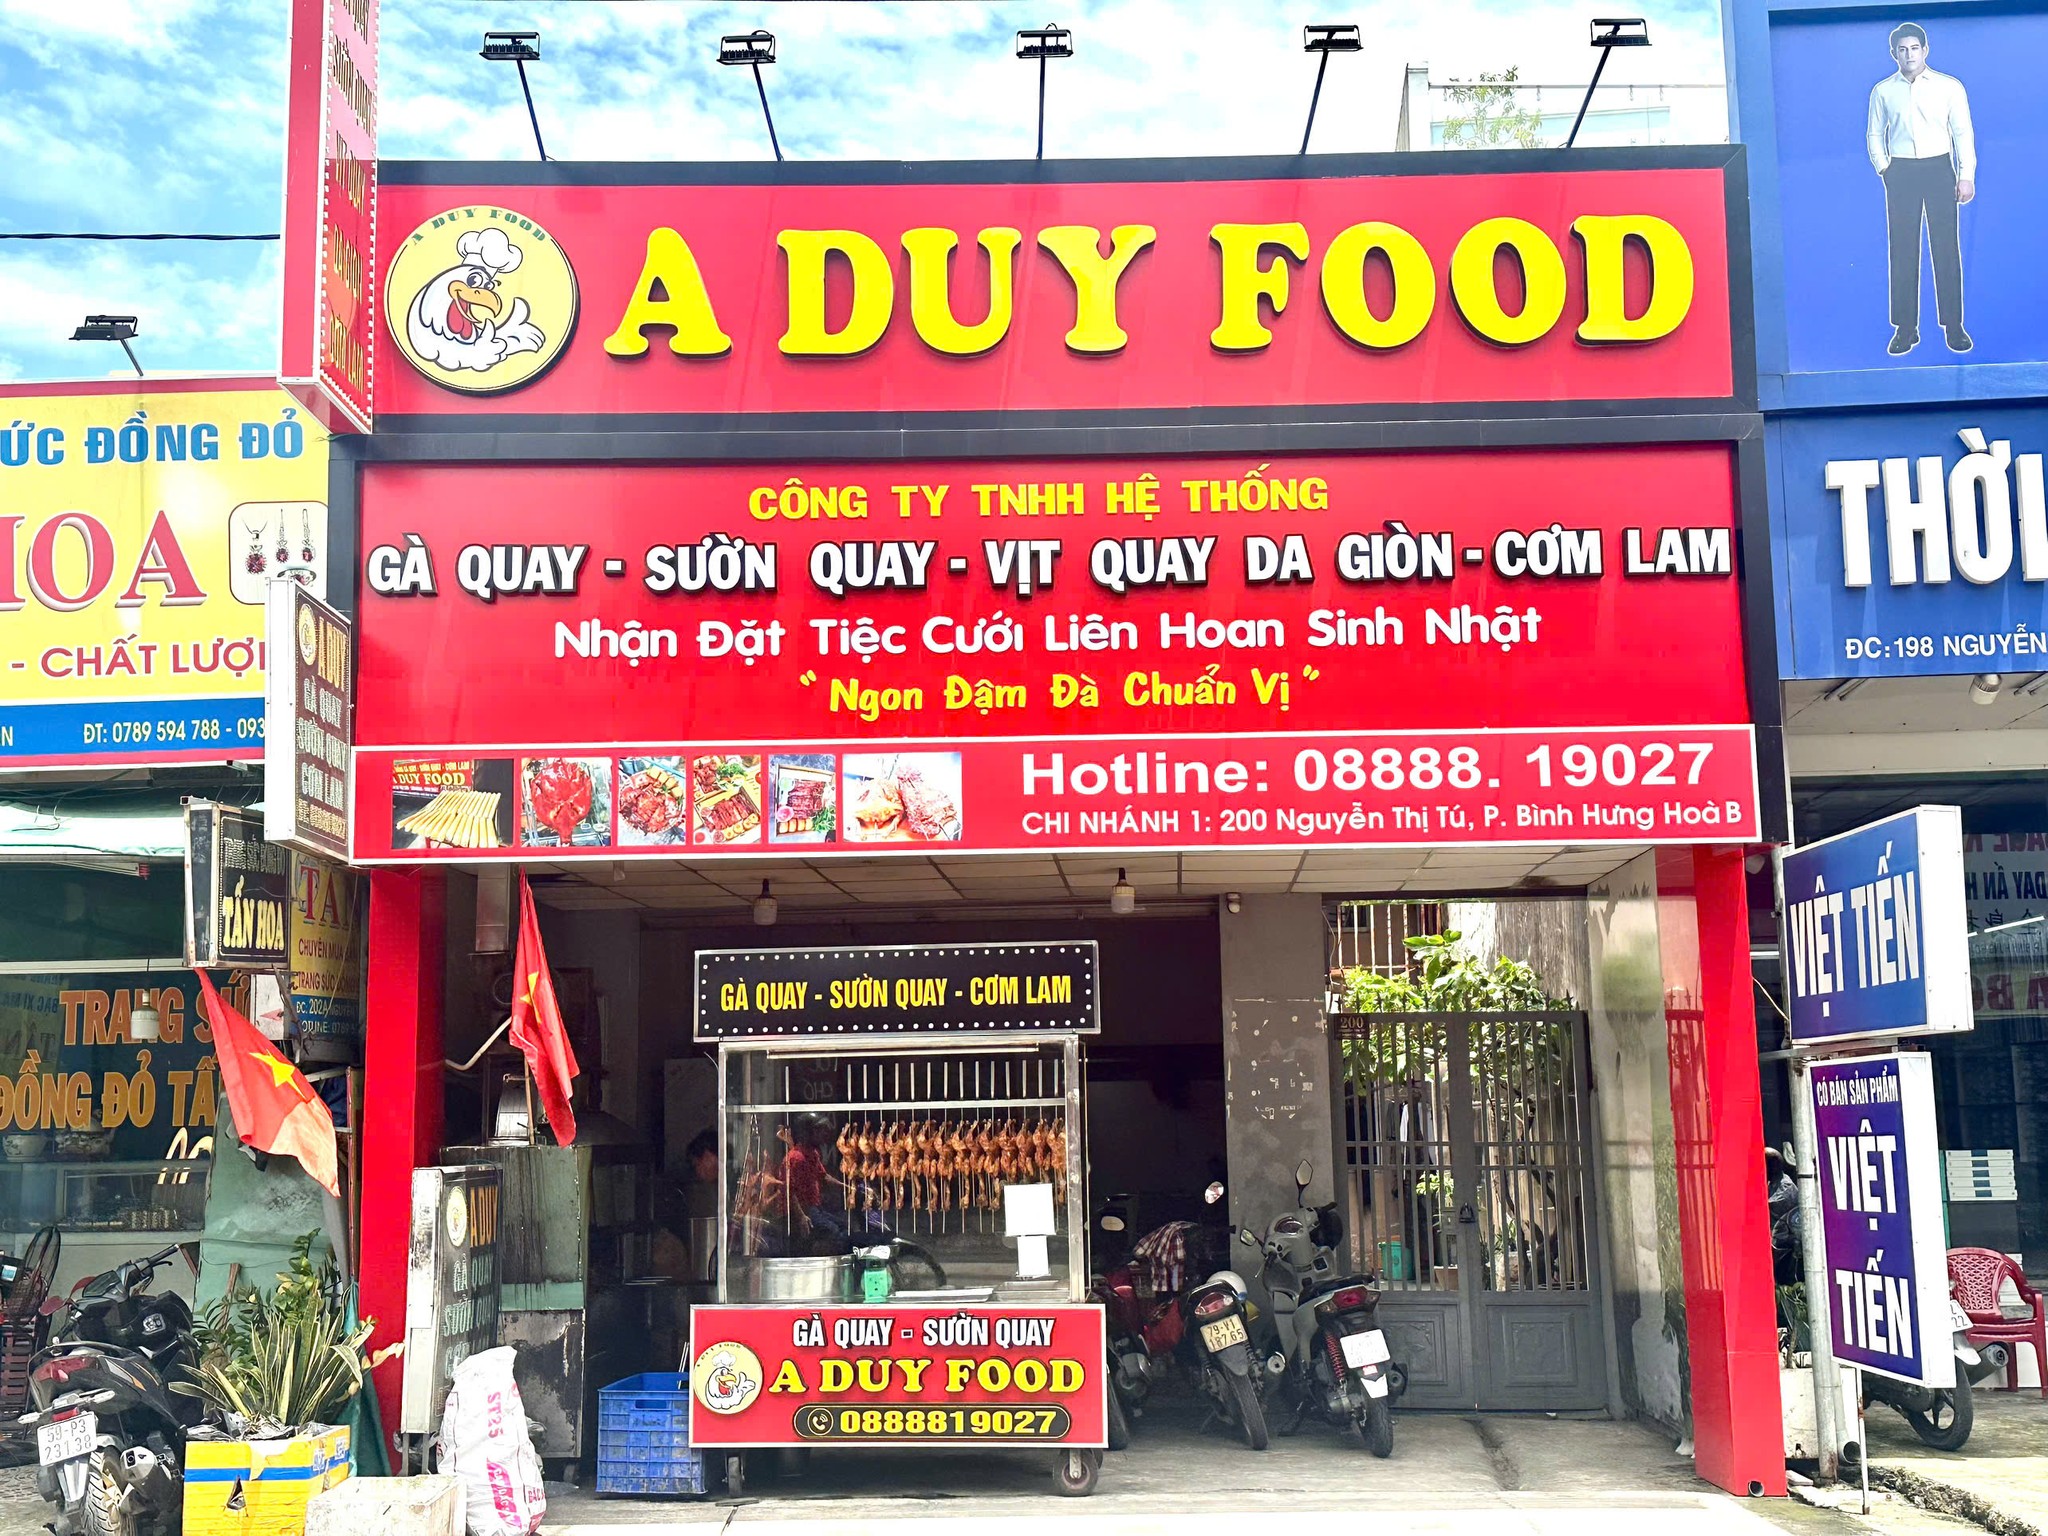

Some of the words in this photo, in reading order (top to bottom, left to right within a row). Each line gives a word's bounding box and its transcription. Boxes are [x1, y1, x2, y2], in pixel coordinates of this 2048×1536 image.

[411, 233, 424, 246] A
[431, 207, 478, 230] DUY
[489, 209, 546, 242] FOOD
[603, 227, 732, 357] A
[777, 225, 1157, 357] DUY
[1208, 214, 1694, 353] FOOD
[84, 410, 219, 464] ĐỒNG
[238, 408, 304, 459] ĐỎ
[748, 477, 868, 520] CÔNG
[891, 485, 950, 518] TY
[972, 483, 1084, 517] TNHH
[1106, 472, 1160, 521] HỆ
[1182, 463, 1328, 513] THỐNG
[367, 533, 436, 596] GÀ
[456, 544, 589, 602] QUAY
[645, 533, 777, 596] SƯỜN
[809, 540, 938, 597] QUAY
[983, 538, 1061, 598] VỊT
[1089, 535, 1217, 598] QUAY
[1244, 534, 1314, 585] DA
[1336, 521, 1453, 583] GIÒN
[1493, 522, 1604, 578] CƠM
[1623, 527, 1733, 577] LAM
[41, 634, 156, 678] CHẤT
[172, 637, 265, 677] LƯỢ
[555, 619, 677, 667] Nhận
[696, 619, 786, 665] Đặt
[809, 616, 906, 664] Tiệc
[922, 610, 1024, 654] Cưới
[1045, 614, 1137, 652] Liên
[1159, 612, 1285, 650] Hoan
[1307, 606, 1403, 648] Sinh
[1426, 604, 1542, 652] Nhật
[1943, 622, 2047, 657] NGUYỄN
[829, 677, 923, 722] Ngon
[944, 675, 1027, 716] Đậm
[1050, 673, 1099, 708] Đà
[1124, 664, 1236, 707] Chuẩn
[1251, 667, 1290, 711] Vị
[84, 721, 108, 744] ĐT:
[112, 719, 151, 743] 0789
[156, 718, 186, 742] 594
[191, 717, 219, 740] 788
[423, 772, 466, 785] FOOD
[1022, 752, 1268, 795] Hotline:
[1294, 748, 1500, 791] 08888.
[1526, 742, 1714, 787] 19027
[1022, 811, 1069, 834] CHI
[1080, 805, 1180, 833] NHÁNH
[1190, 809, 1211, 832] 1:
[1220, 808, 1267, 832] 200
[1276, 801, 1384, 836] Nguyễn
[1392, 806, 1429, 833] Thị
[1436, 804, 1475, 831] Tú,
[1484, 805, 1507, 827] P.
[1517, 802, 1573, 827] Bình
[1583, 803, 1655, 831] Hưng
[1664, 799, 1720, 825] Hoà
[1727, 801, 1742, 824] B
[223, 875, 255, 948] TẤN
[256, 900, 285, 950] HOA
[1790, 874, 1844, 1017] VIỆT
[1850, 840, 1919, 989] TIẾN
[298, 971, 320, 990] TRANG
[720, 976, 748, 1011] GÀ
[755, 981, 807, 1013] QUAY
[829, 973, 888, 1009] SƯỜN
[895, 977, 947, 1010] QUAY
[970, 975, 1019, 1006] CƠM
[1025, 974, 1072, 1004] LAM
[1340, 1016, 1364, 1029] 200
[101, 1049, 156, 1128] ĐỎ
[168, 1052, 222, 1127] TẤ
[1817, 1076, 1828, 1107] CÓ
[1829, 1076, 1848, 1106] BÁN
[1849, 1069, 1869, 1105] SẢN
[1870, 1065, 1899, 1103] PHẨM
[1827, 1119, 1897, 1231] VIỆT
[470, 1186, 479, 1247] A
[478, 1184, 499, 1245] DUY
[471, 1255, 494, 1286] QUAY
[1835, 1249, 1914, 1359] TIẾN
[793, 1314, 827, 1347] GÀ
[833, 1317, 896, 1350] QUAY
[922, 1312, 991, 1348] SƯỜN
[994, 1317, 1055, 1350] QUAY
[769, 1359, 807, 1394] A
[818, 1359, 932, 1393] DUY
[944, 1358, 1086, 1394] FOOD
[840, 1410, 1057, 1434] 0888819027
